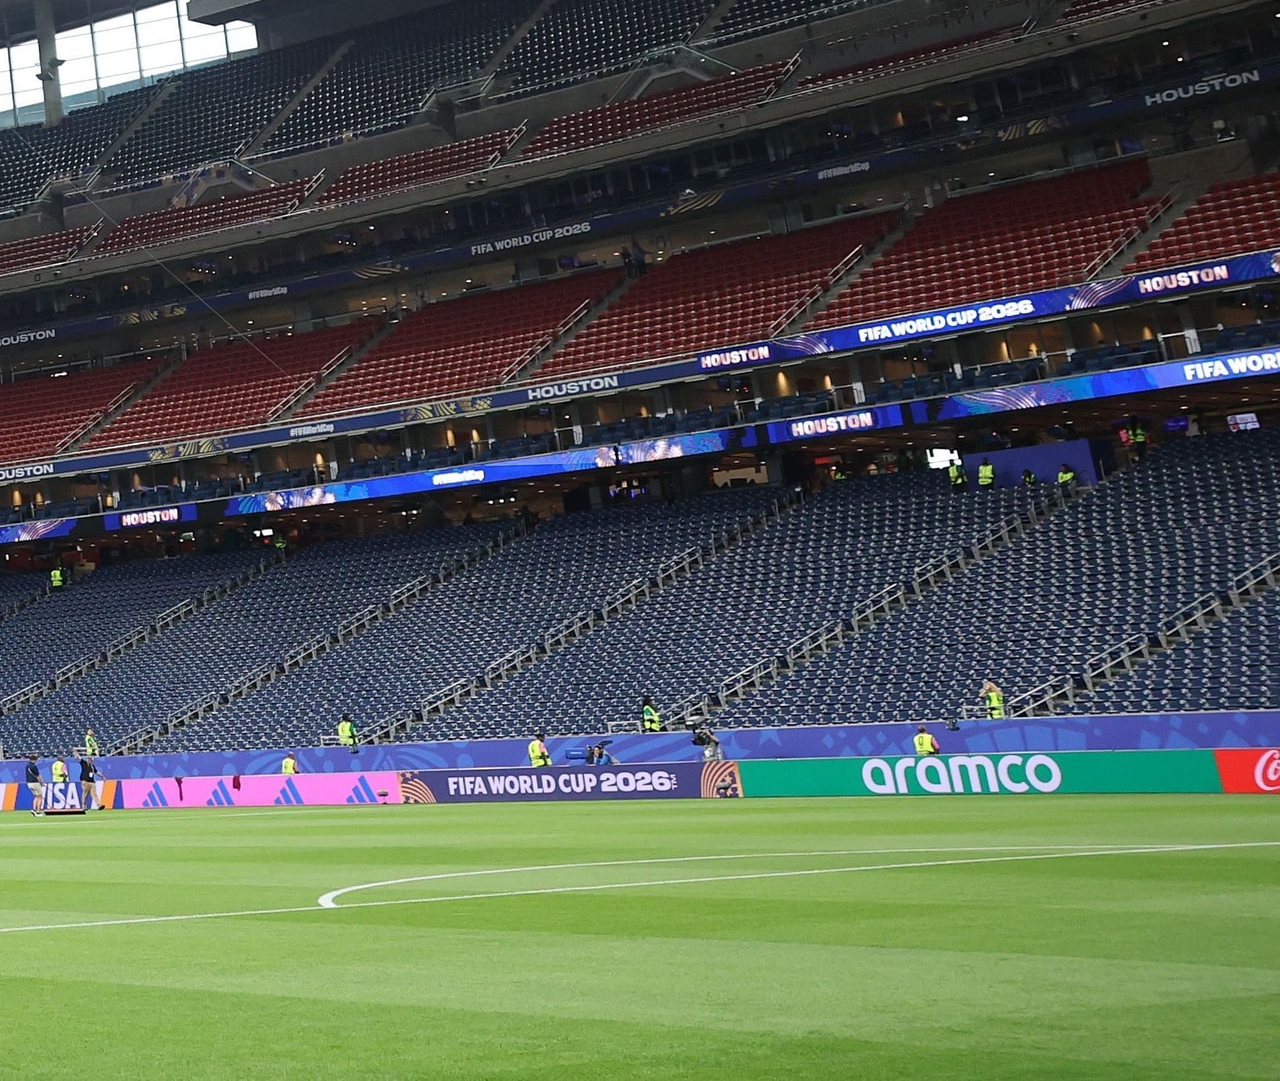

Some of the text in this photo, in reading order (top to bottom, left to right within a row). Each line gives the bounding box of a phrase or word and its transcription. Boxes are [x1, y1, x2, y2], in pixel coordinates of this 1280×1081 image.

[1144, 70, 1260, 106] HOUSTON
[471, 222, 591, 255] FIFA WORLD CUP 2026
[1138, 265, 1228, 293] HOUSTON
[858, 299, 1034, 342] FIFA WORLD CUP 2026
[701, 346, 770, 368] HOUSTON
[1183, 359, 1229, 381] FIFA
[527, 376, 618, 400] HOUSTON
[791, 412, 873, 436] HOUSTON
[122, 508, 178, 526] HOUSTON
[447, 776, 488, 795] FIFA
[487, 774, 556, 794] WORLD
[558, 772, 597, 793] CUP
[599, 771, 671, 792] 2026
[861, 754, 1062, 794] aramco
